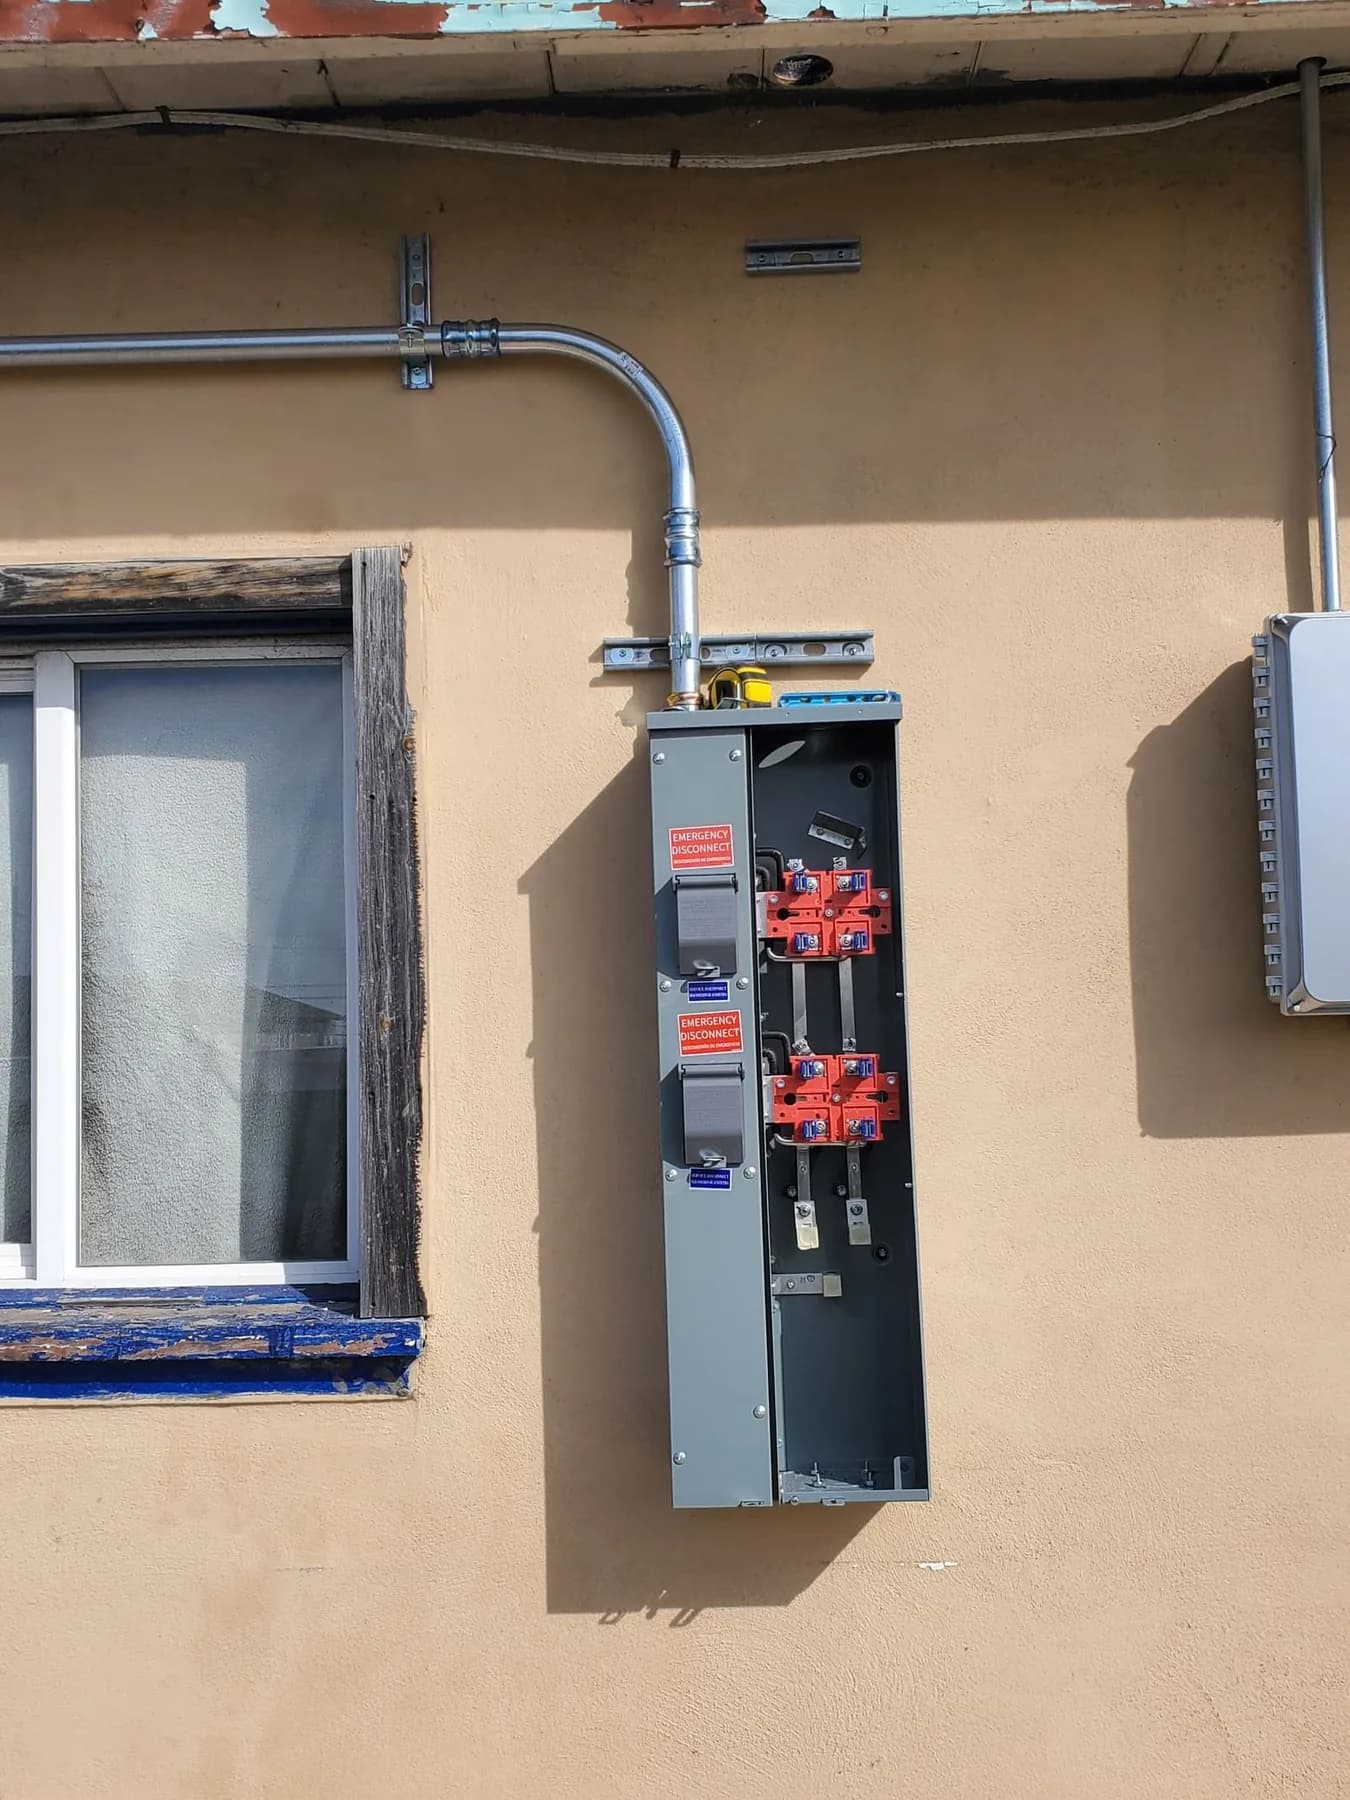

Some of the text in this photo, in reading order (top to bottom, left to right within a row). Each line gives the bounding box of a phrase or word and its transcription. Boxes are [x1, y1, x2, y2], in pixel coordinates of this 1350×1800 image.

[672, 829, 729, 842] EMERGENCY
[672, 842, 730, 855] DISCONNECT
[681, 1015, 737, 1028] EMERGENCY
[680, 1028, 740, 1041] DISCONNECT
